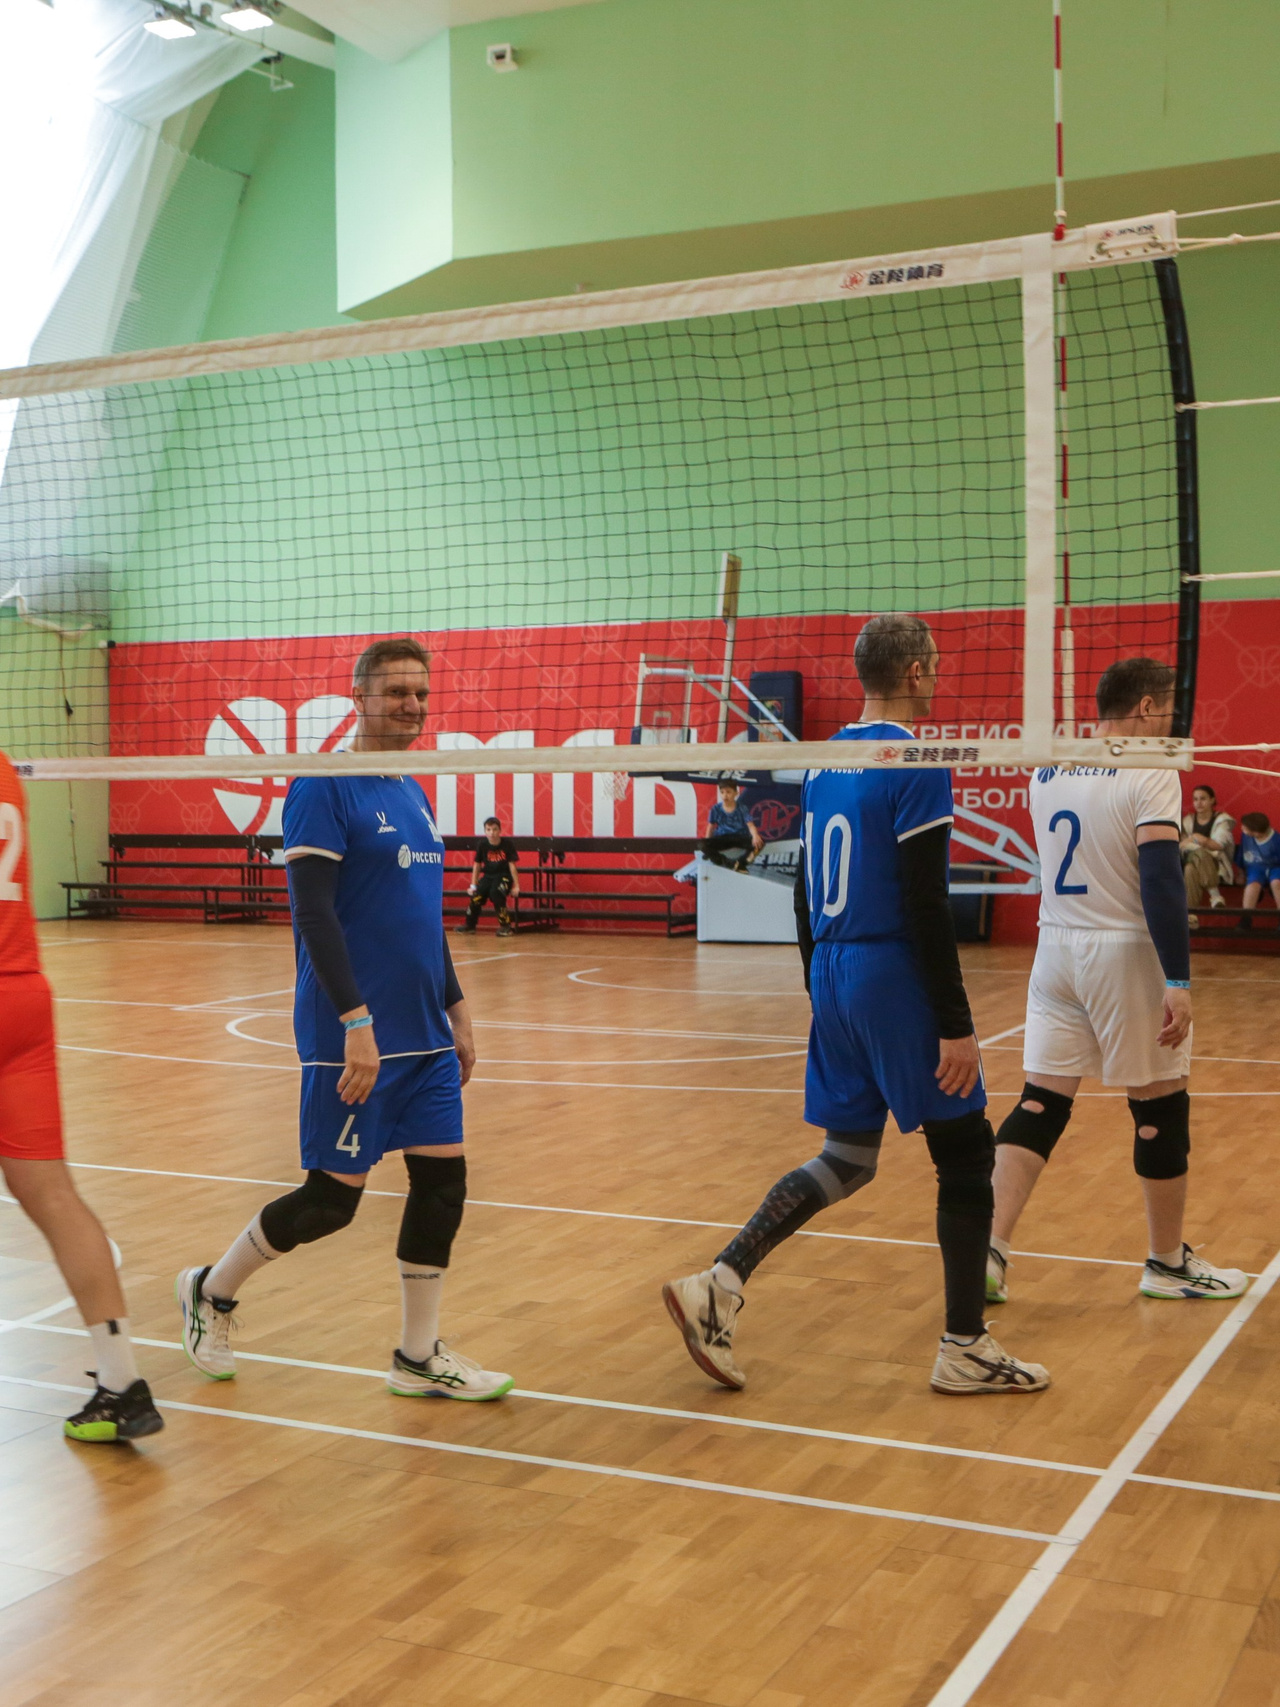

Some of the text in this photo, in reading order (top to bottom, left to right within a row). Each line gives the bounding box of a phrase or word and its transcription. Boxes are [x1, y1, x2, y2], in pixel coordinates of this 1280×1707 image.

[411, 851, 442, 864] РОССЕТИ
[1048, 809, 1088, 896] 2
[335, 1114, 361, 1158] 4
